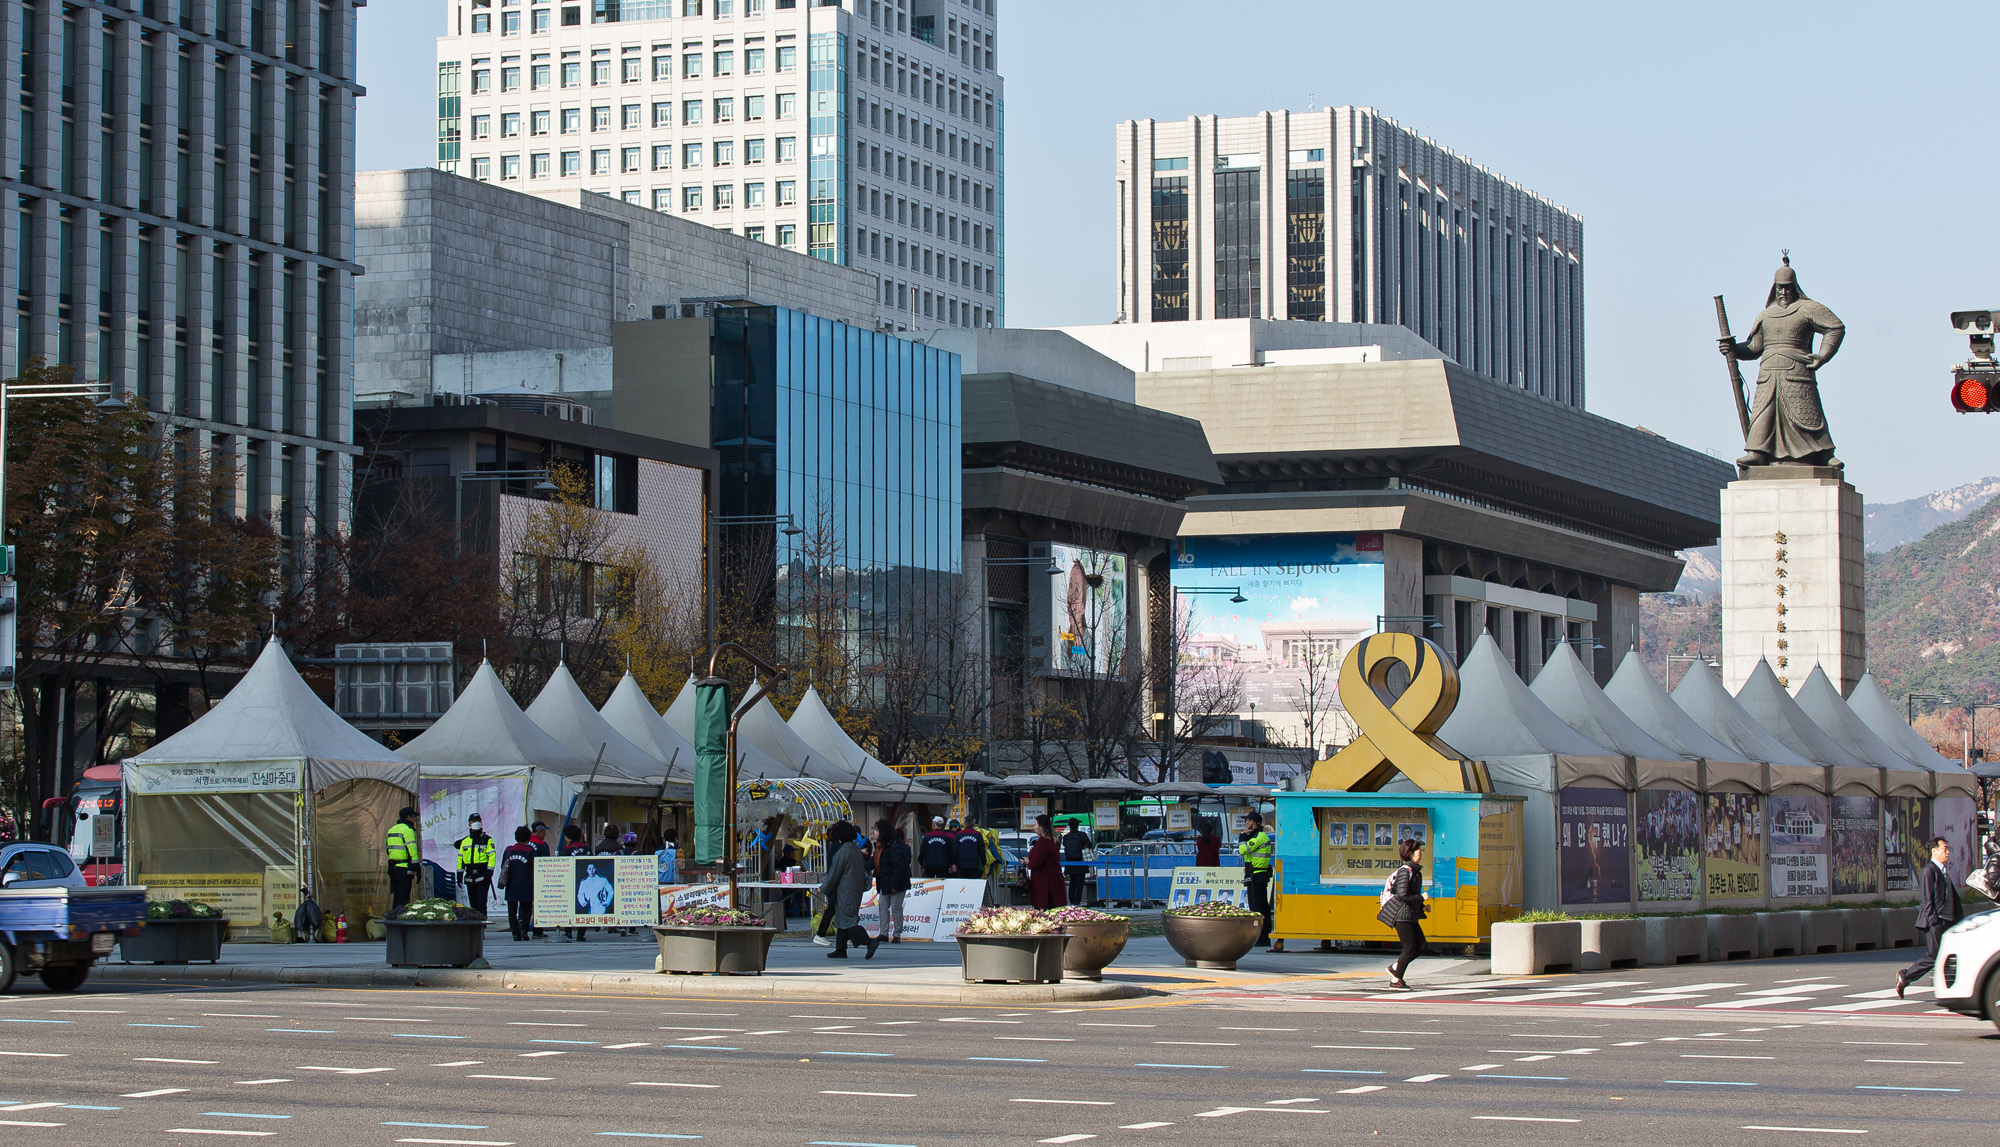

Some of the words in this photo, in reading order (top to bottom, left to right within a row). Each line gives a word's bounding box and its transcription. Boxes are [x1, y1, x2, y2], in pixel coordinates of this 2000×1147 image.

[1178, 554, 1194, 563] 40
[1211, 562, 1247, 576] FALL
[1253, 563, 1271, 576] IN
[1276, 561, 1340, 577] SEJONG
[1248, 580, 1260, 588] 세종
[1262, 580, 1281, 588] 향기에
[1283, 579, 1302, 587] 빠지다
[194, 776, 220, 786] 서명으로
[252, 771, 296, 786] 진실마중대
[1126, 807, 1140, 815] 7016
[1563, 822, 1571, 847] 왜
[1577, 822, 1586, 847] 안
[1593, 823, 1627, 848] 구했나?
[1348, 859, 1372, 869] 당신을
[1709, 873, 1726, 894] 감추는
[1728, 873, 1736, 893] 자,
[1737, 873, 1759, 893] 범인이다
